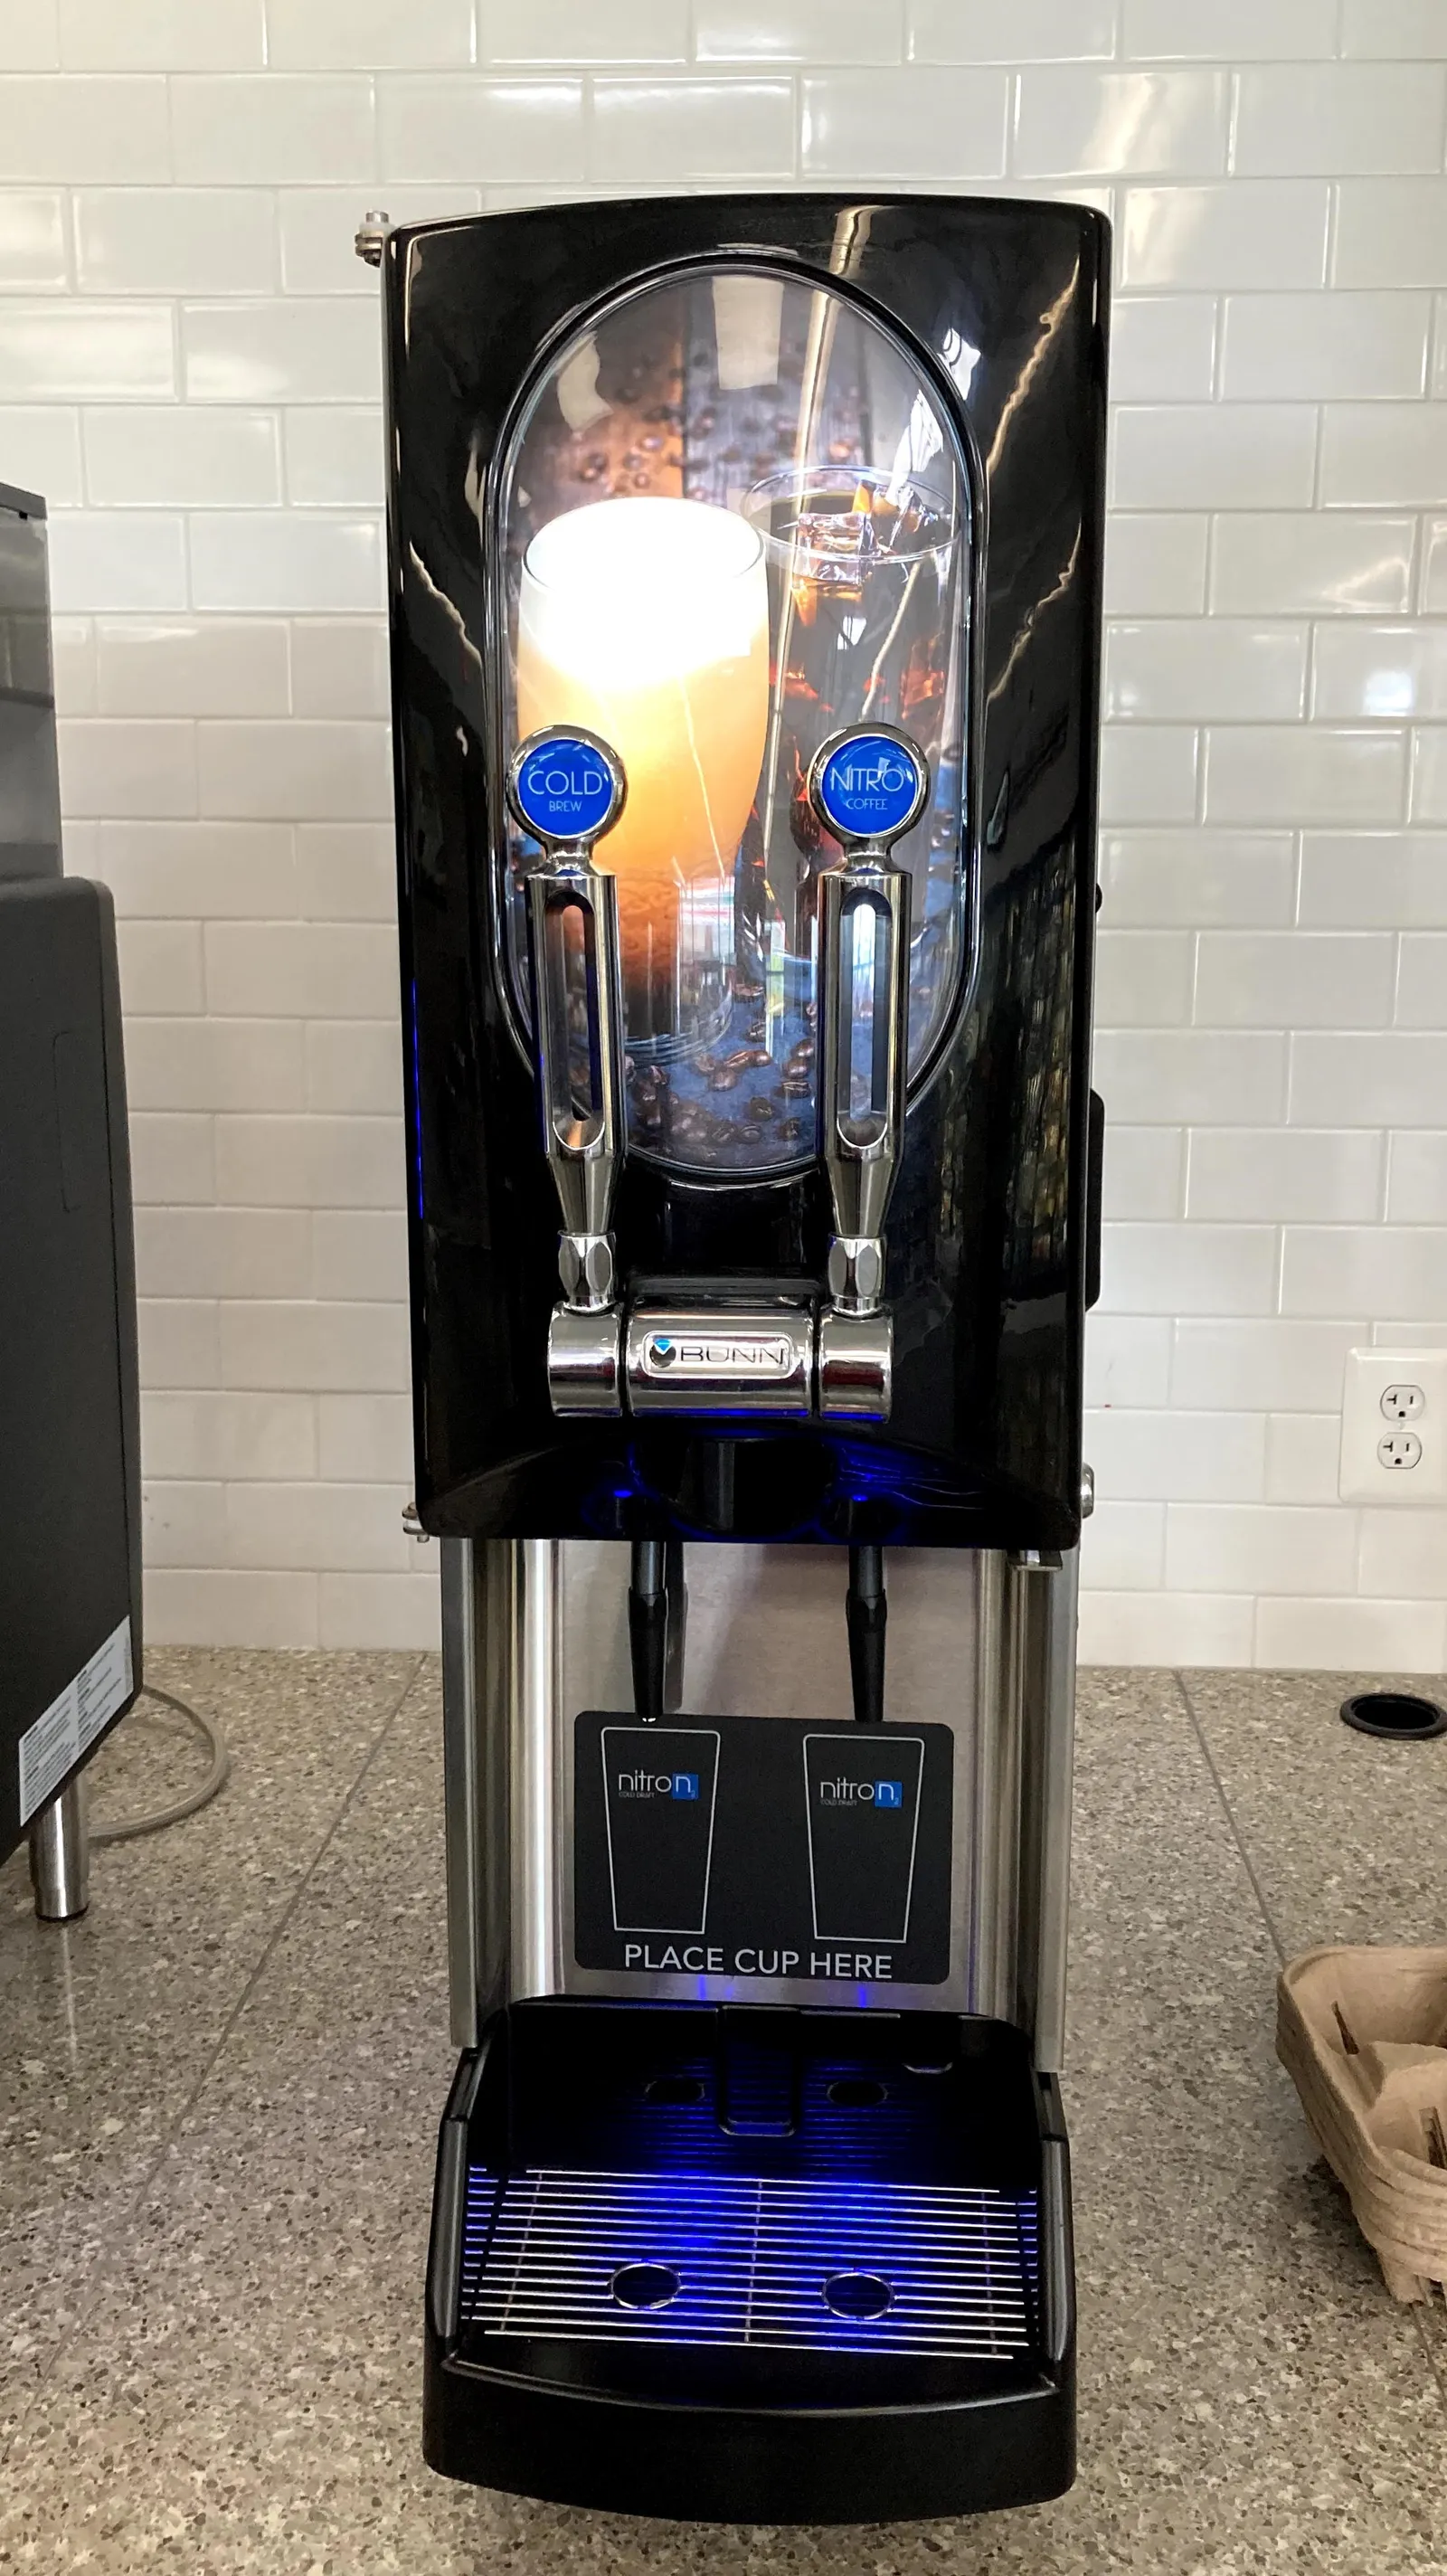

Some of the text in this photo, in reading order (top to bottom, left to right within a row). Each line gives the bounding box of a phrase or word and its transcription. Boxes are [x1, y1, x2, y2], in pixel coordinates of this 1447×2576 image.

[527, 771, 603, 795] COLD
[830, 767, 904, 792] NITRO
[548, 800, 582, 812] BREW
[846, 798, 888, 810] COFFEE
[680, 1346, 785, 1365] BUNN
[625, 1945, 893, 1979] PLACE CUP HERE
